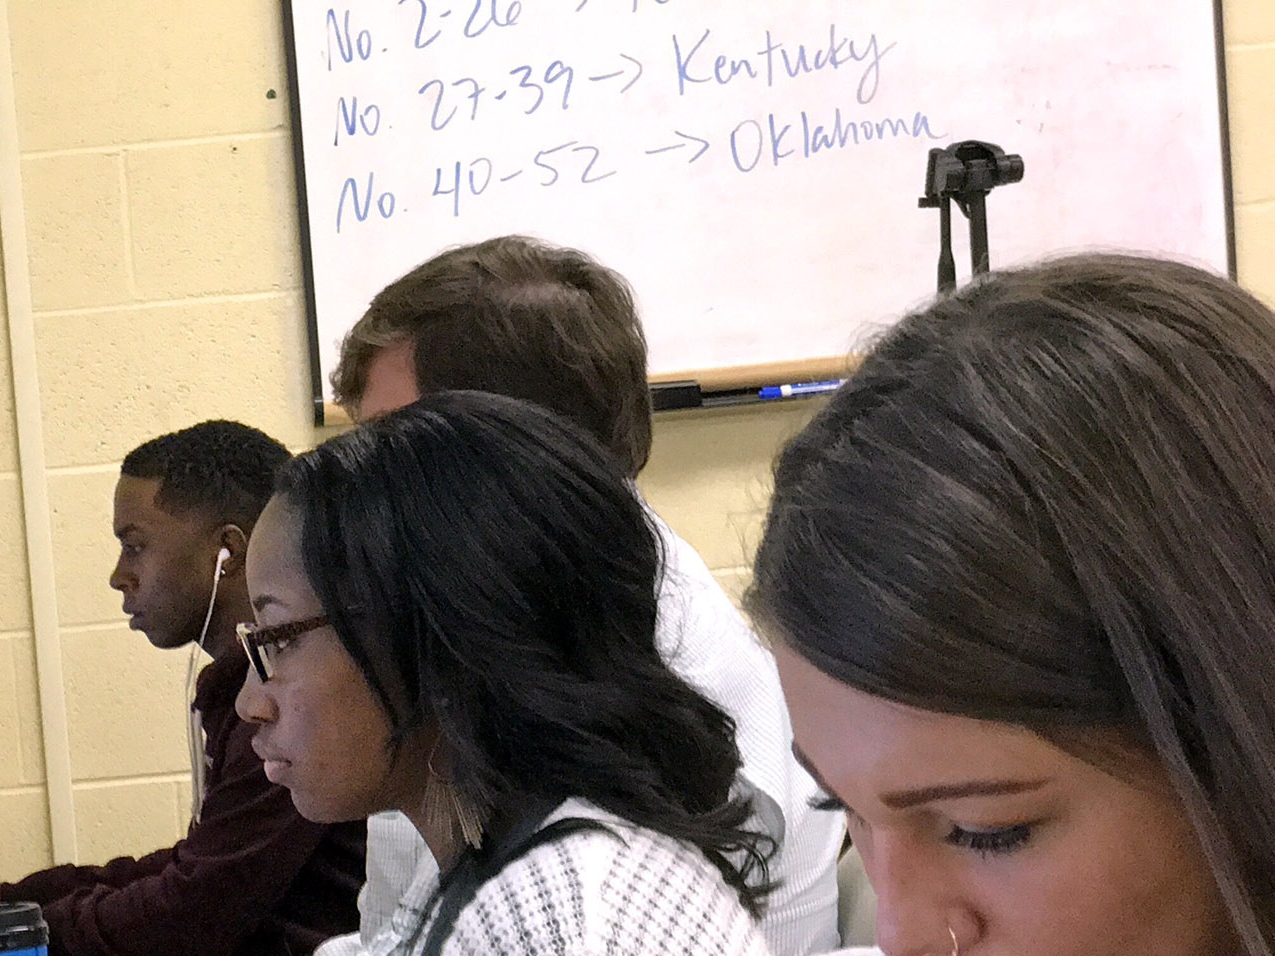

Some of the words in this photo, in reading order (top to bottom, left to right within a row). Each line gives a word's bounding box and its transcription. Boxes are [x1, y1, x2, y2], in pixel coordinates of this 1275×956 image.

[325, 8, 388, 71] No.
[332, 96, 394, 147] No.
[418, 60, 574, 131] 27-39
[672, 24, 898, 105] Kentucky
[336, 171, 409, 234] No.
[432, 141, 618, 217] 40-52
[730, 108, 949, 172] Oklahoma
